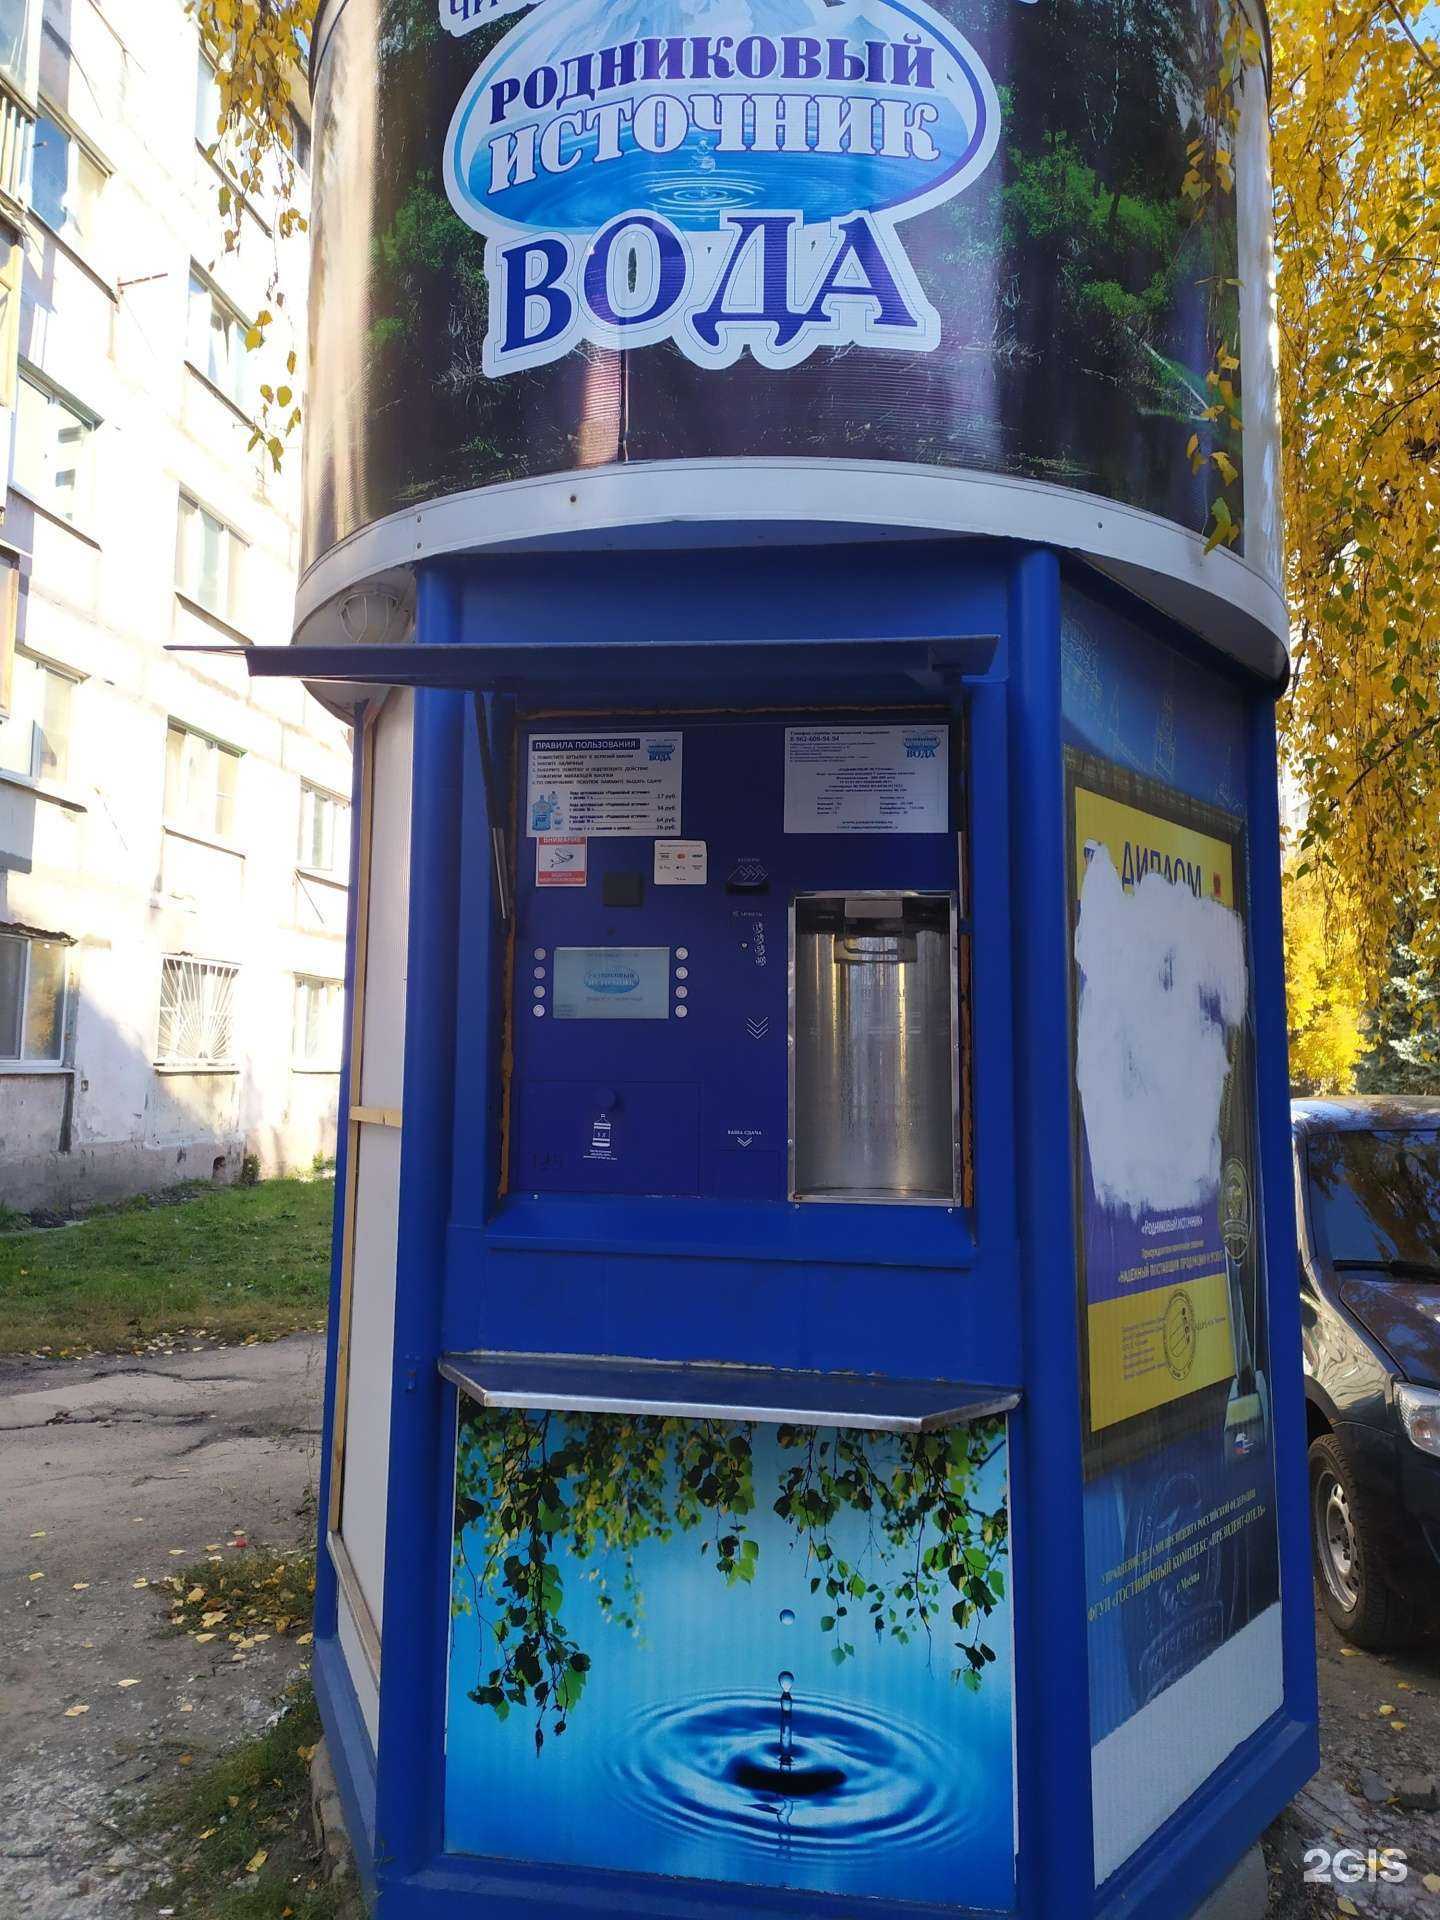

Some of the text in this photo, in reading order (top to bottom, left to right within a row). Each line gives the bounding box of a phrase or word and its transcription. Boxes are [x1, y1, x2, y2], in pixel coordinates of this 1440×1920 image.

[489, 32, 935, 125] РОДНИКОВЫЙ
[487, 94, 941, 195] ИСТОЧНИК
[498, 214, 919, 355] ВОДА
[535, 740, 574, 750] ПРАВИЛА
[1122, 842, 1202, 898] ДИПЛОМ
